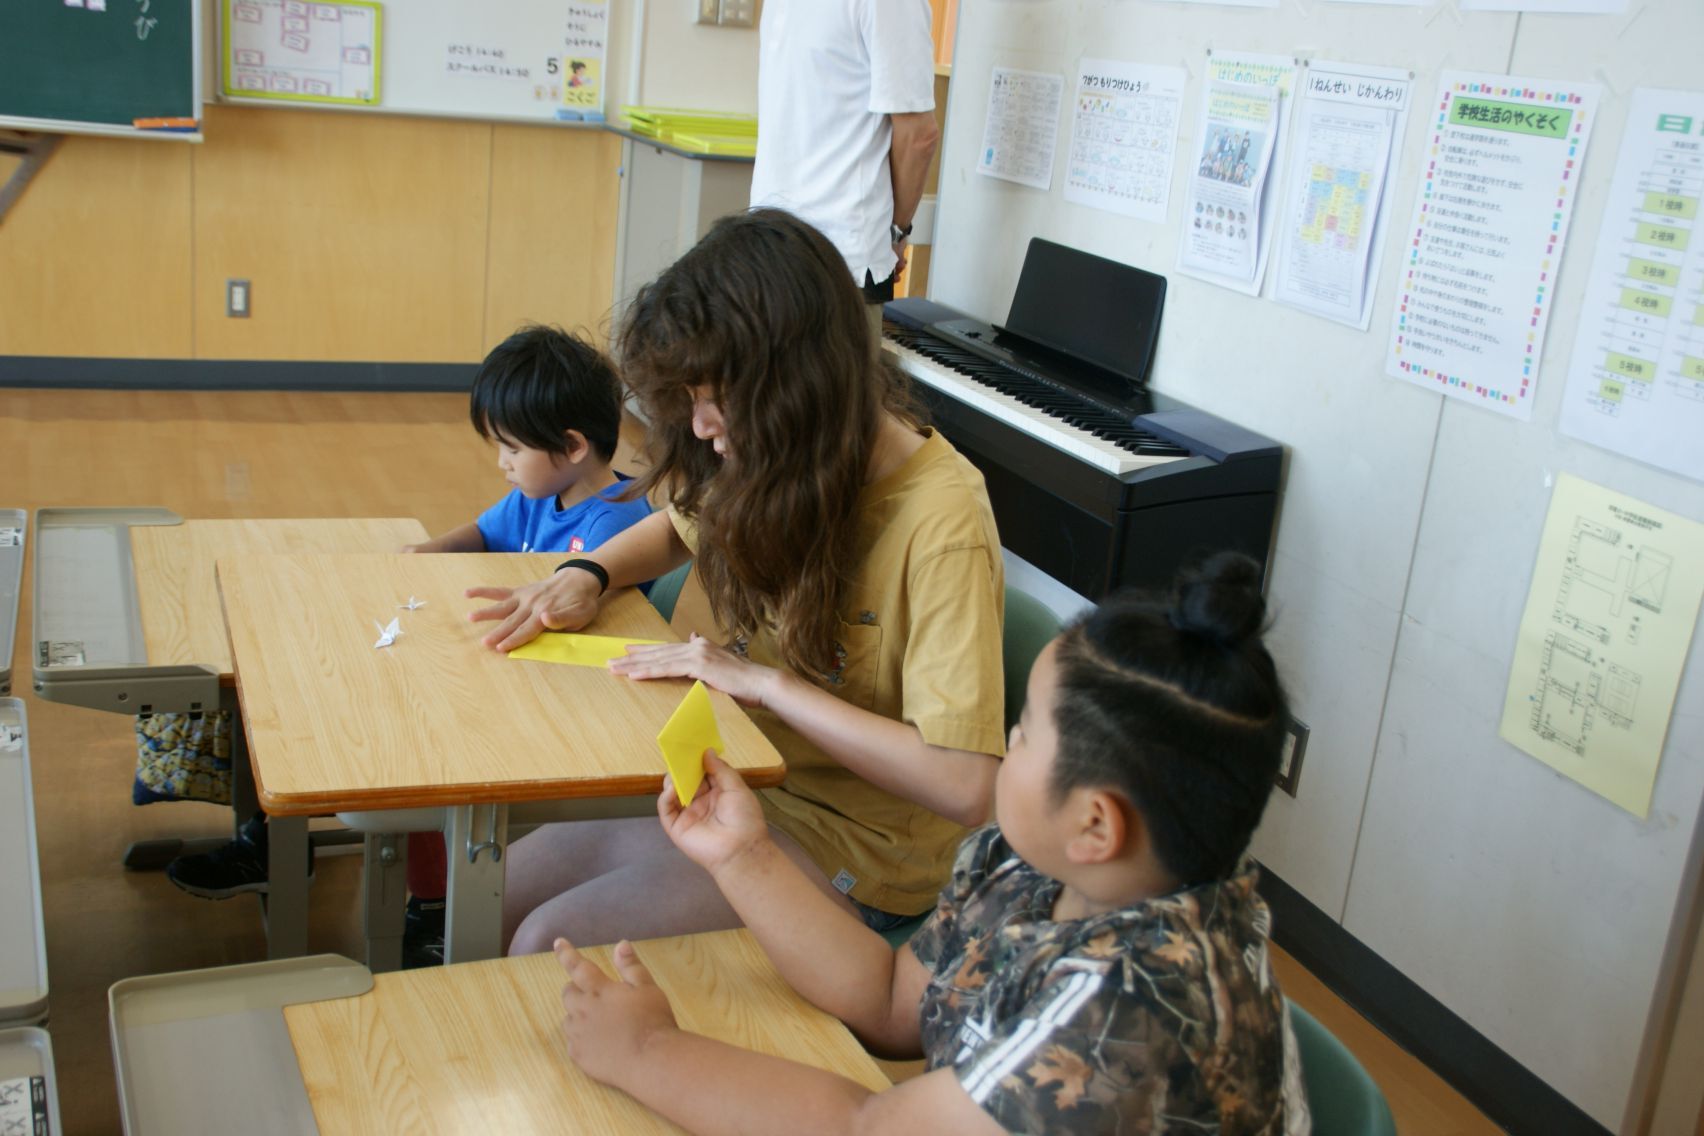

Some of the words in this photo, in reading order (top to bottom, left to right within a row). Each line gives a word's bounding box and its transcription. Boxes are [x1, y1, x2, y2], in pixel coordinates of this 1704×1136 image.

[547, 57, 559, 75] 5
[1357, 82, 1403, 103] じかんわり
[1457, 102, 1560, 131] 学校生活のやくそく
